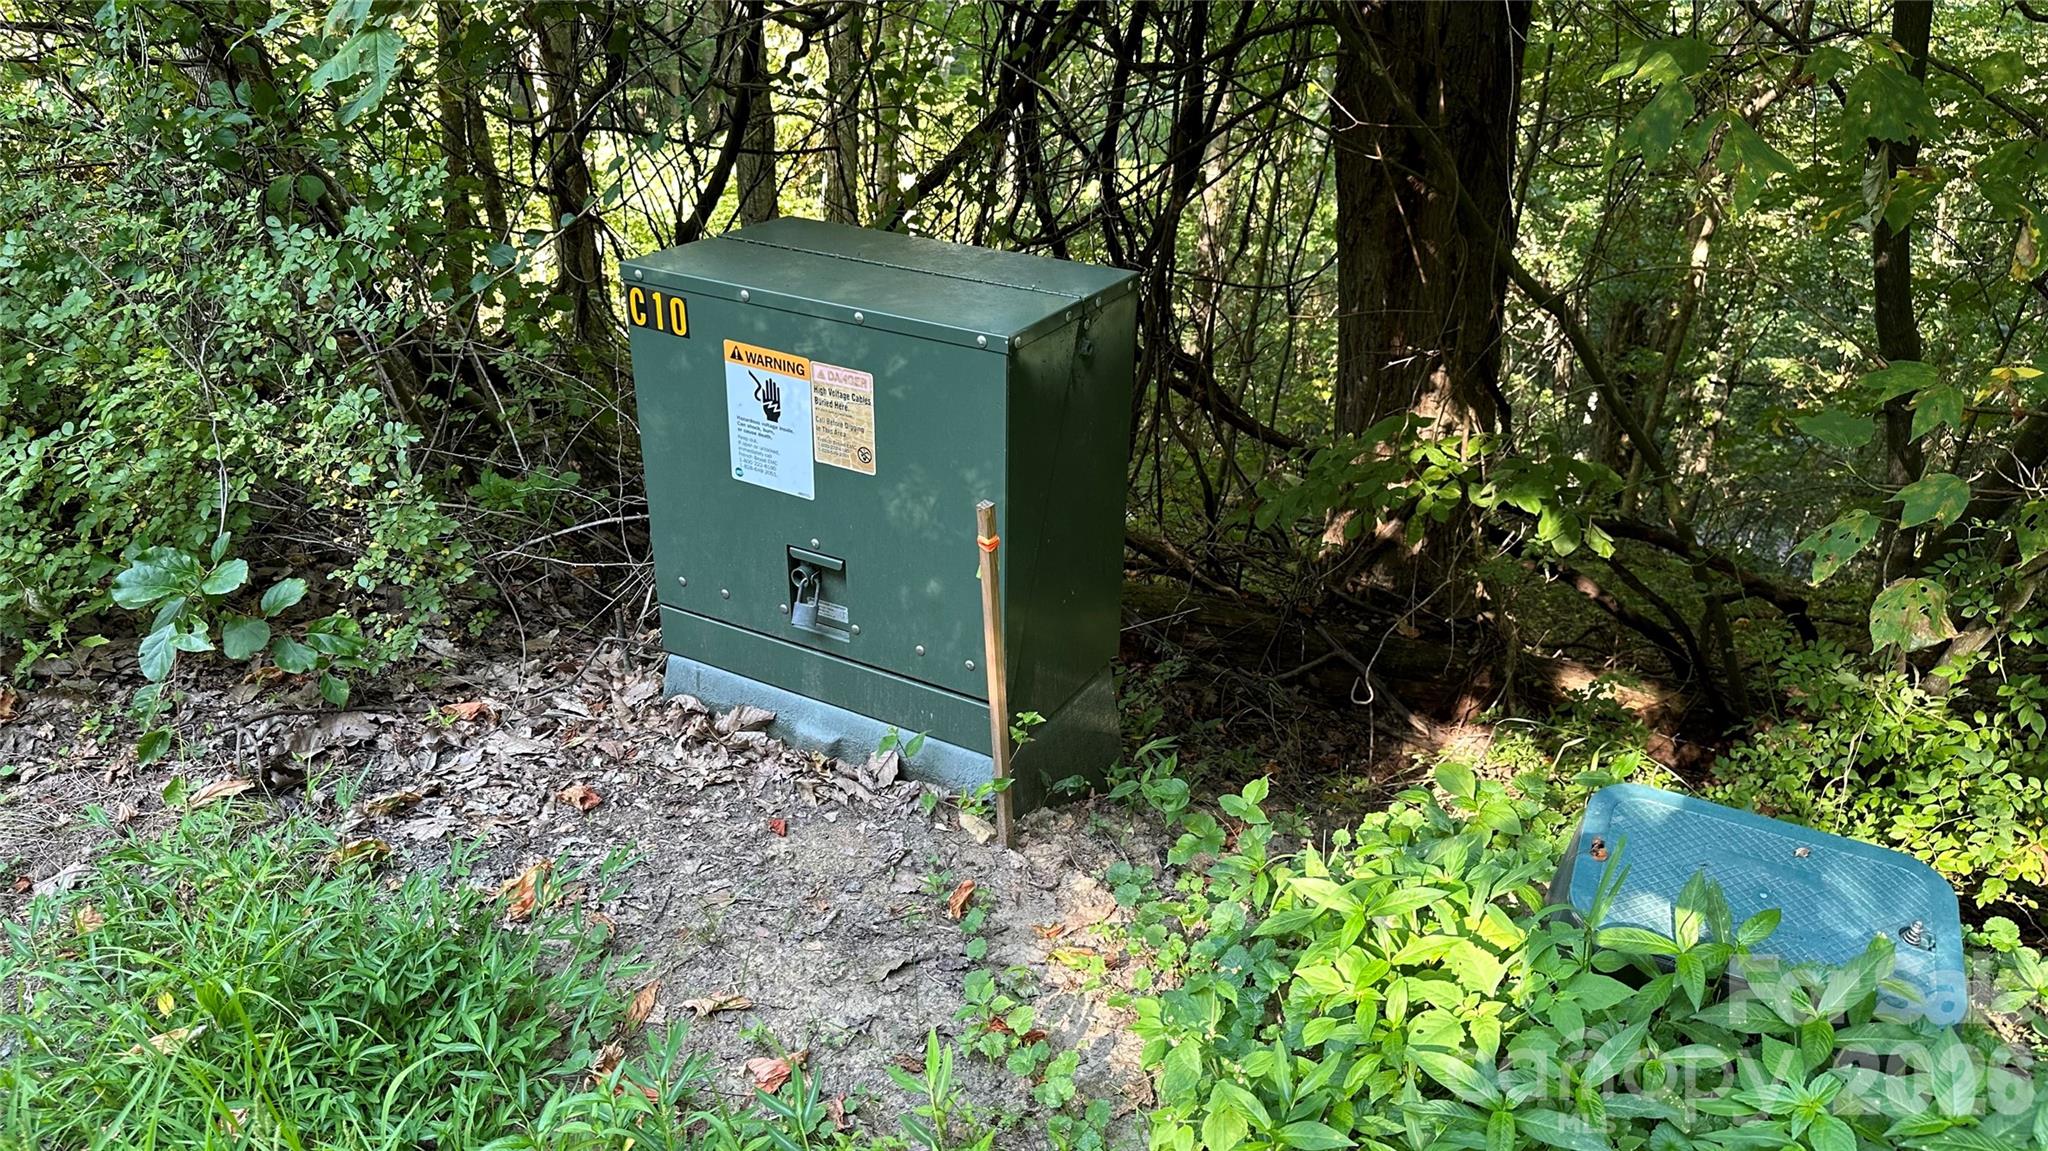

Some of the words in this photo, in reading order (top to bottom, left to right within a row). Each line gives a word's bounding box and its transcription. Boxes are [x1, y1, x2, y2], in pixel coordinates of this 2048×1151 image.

[629, 286, 687, 336] C10
[745, 350, 806, 376] WARNING
[827, 370, 867, 387] DANGER
[814, 385, 827, 396] High
[828, 388, 850, 402] Voltage
[851, 393, 872, 406] Cables
[814, 396, 833, 408] Buried
[826, 417, 844, 428] Before
[844, 422, 865, 434] Digging
